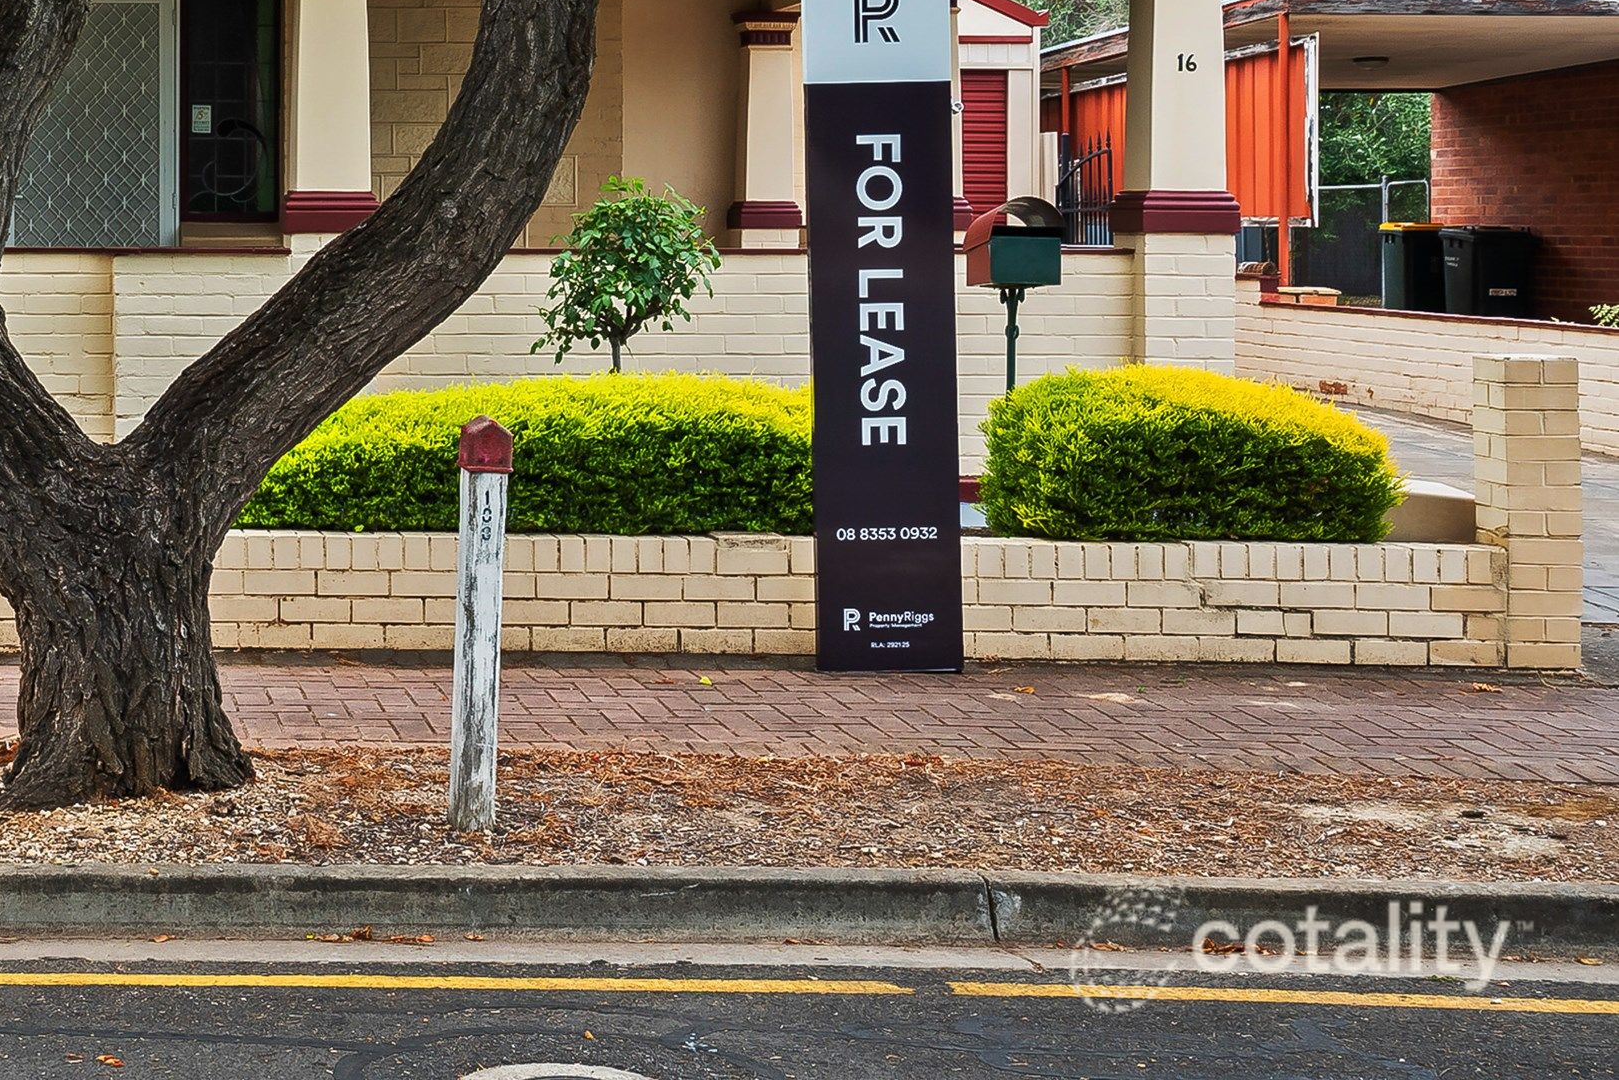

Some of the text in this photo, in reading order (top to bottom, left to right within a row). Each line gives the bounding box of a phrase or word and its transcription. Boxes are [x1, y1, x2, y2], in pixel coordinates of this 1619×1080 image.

[1177, 53, 1197, 72] 16
[855, 133, 907, 446] FOR LEASE
[836, 526, 938, 541] 08 8353 0932
[869, 611, 935, 624] PennyRiggs
